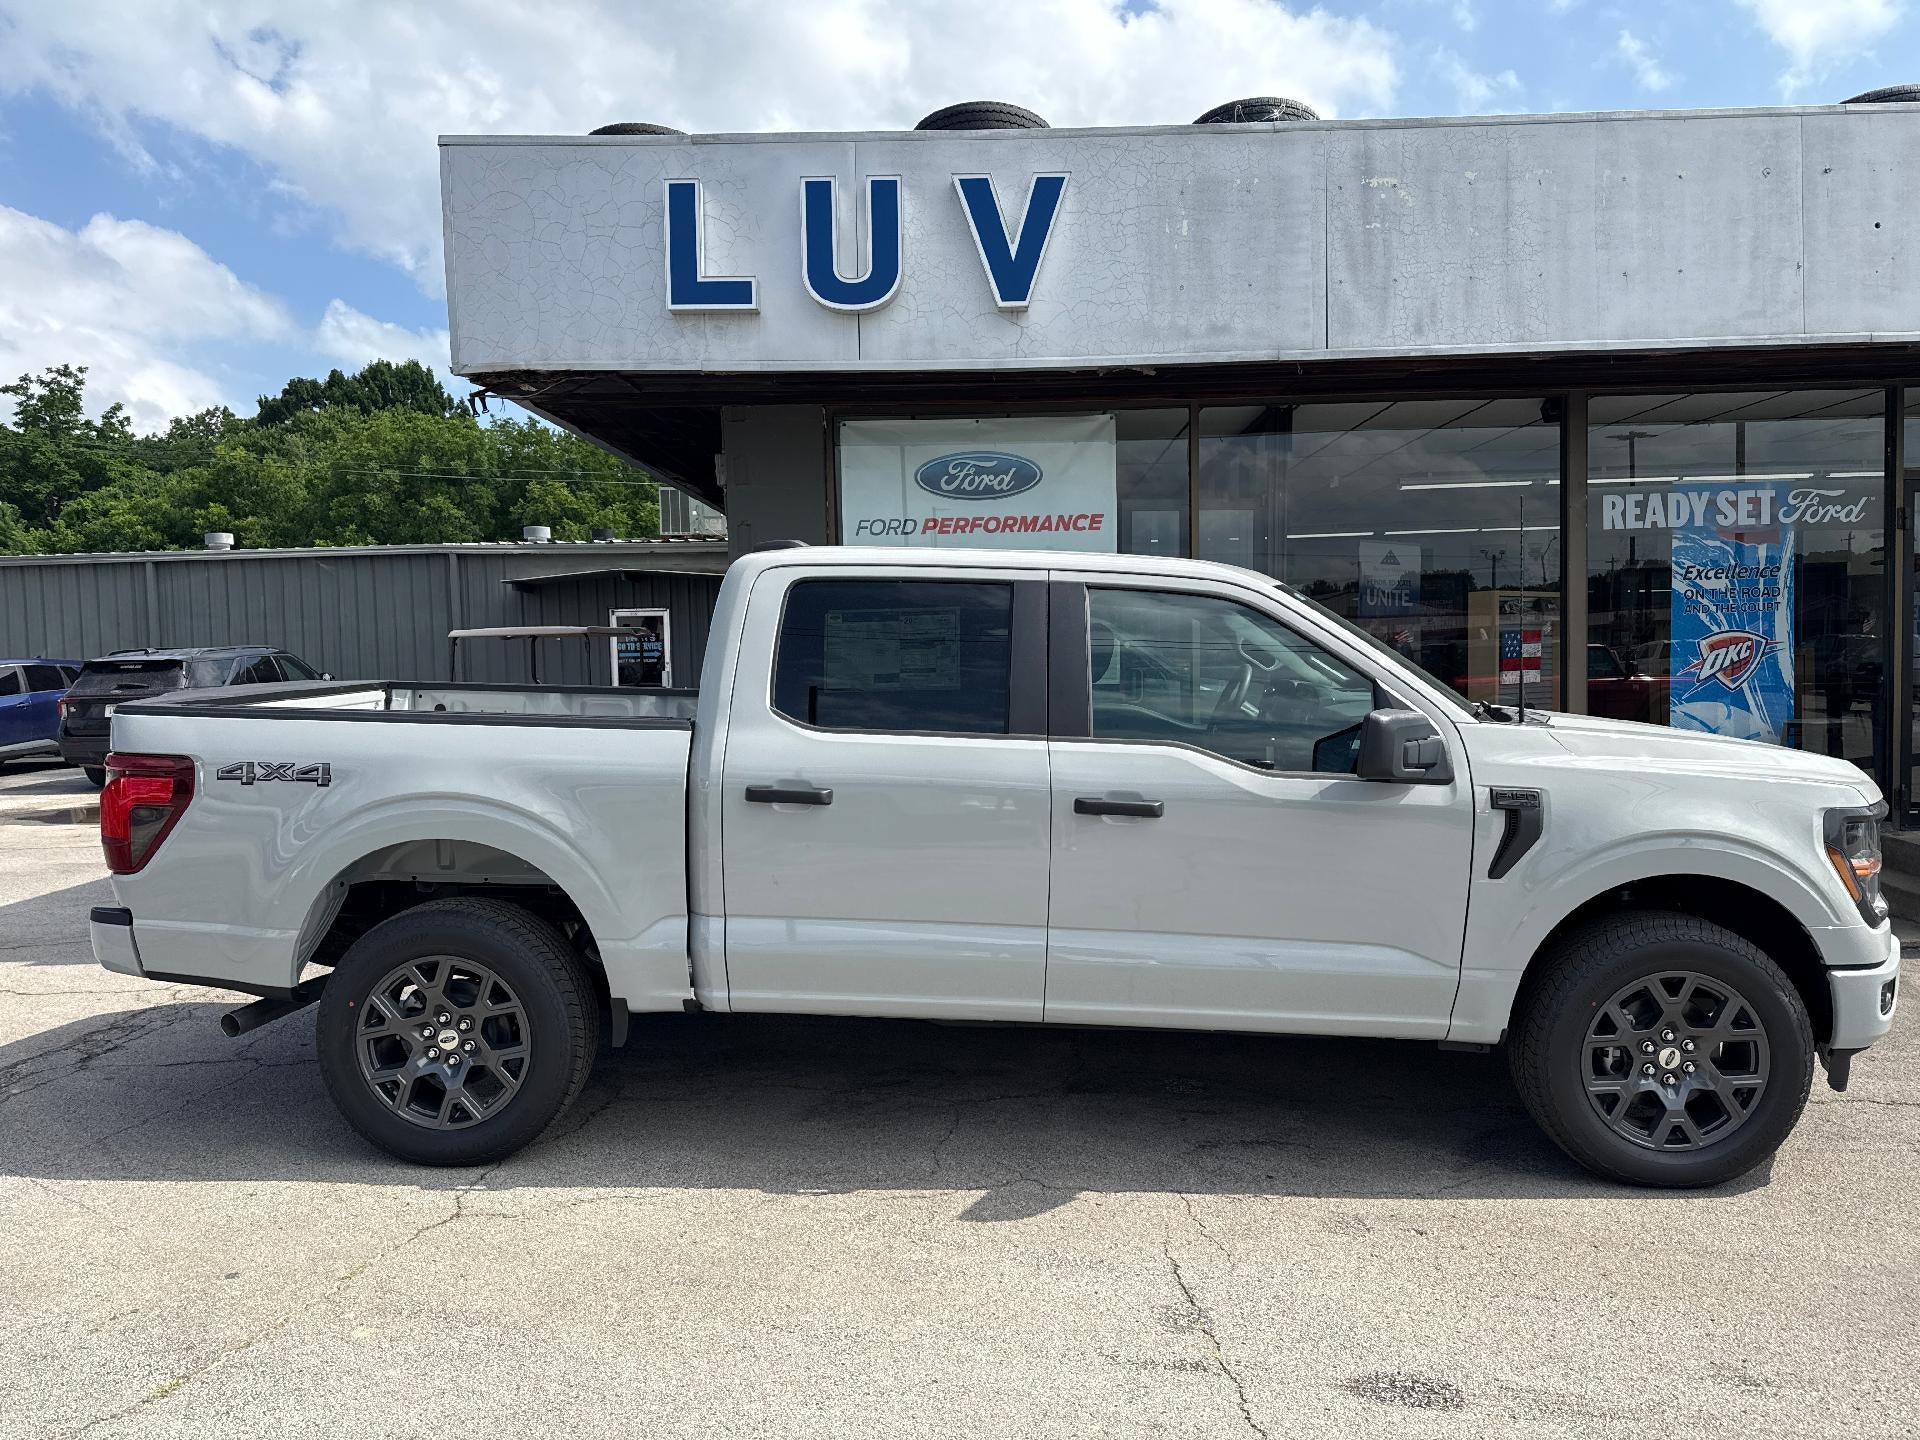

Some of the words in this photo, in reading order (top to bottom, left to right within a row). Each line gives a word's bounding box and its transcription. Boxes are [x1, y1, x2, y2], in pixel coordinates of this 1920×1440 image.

[664, 172, 1072, 315] LUV
[940, 460, 1017, 491] Ford
[1602, 491, 1711, 530] READY
[1716, 489, 1776, 528] SET
[1778, 488, 1868, 524] Ford
[855, 518, 917, 537] FORD
[920, 513, 1105, 535] PERFORMANCE
[1683, 562, 1781, 581] Excellence
[1366, 587, 1414, 607] UNITE
[1684, 588, 1705, 600] ON
[1709, 587, 1737, 600] THE
[1741, 586, 1781, 599] ROAD
[1683, 603, 1710, 615] AND
[1715, 603, 1737, 613] THE
[1740, 601, 1781, 613] COURT
[636, 641, 663, 651] SRVICE
[1699, 640, 1752, 681] OKC
[216, 761, 332, 787] 4X4
